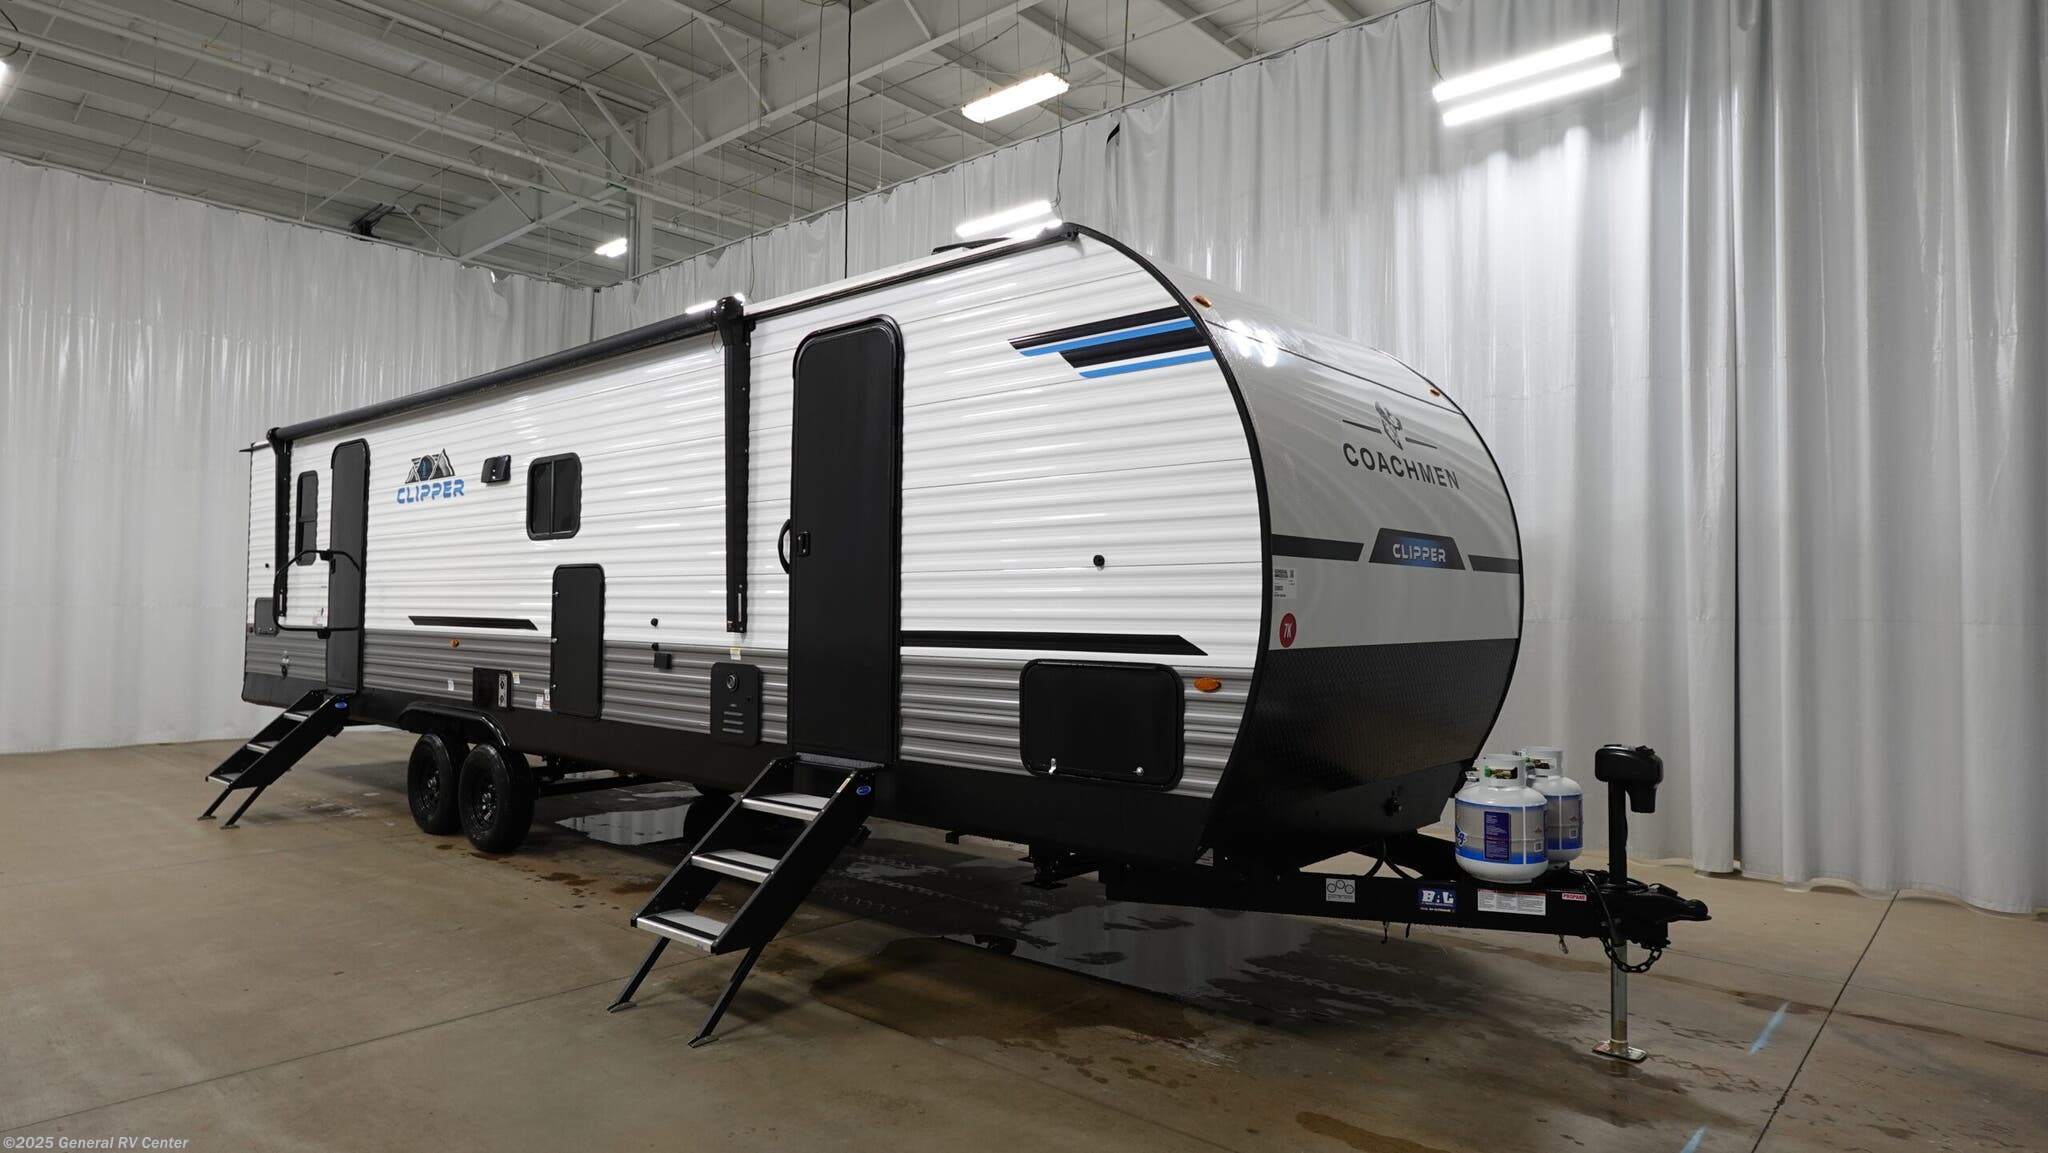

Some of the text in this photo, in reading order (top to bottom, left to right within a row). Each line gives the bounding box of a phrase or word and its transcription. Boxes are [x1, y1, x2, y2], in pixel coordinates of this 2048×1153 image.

[1343, 442, 1460, 490] COACHMEN
[397, 478, 465, 504] CLIPPER
[1392, 543, 1447, 563] CLIPPER
